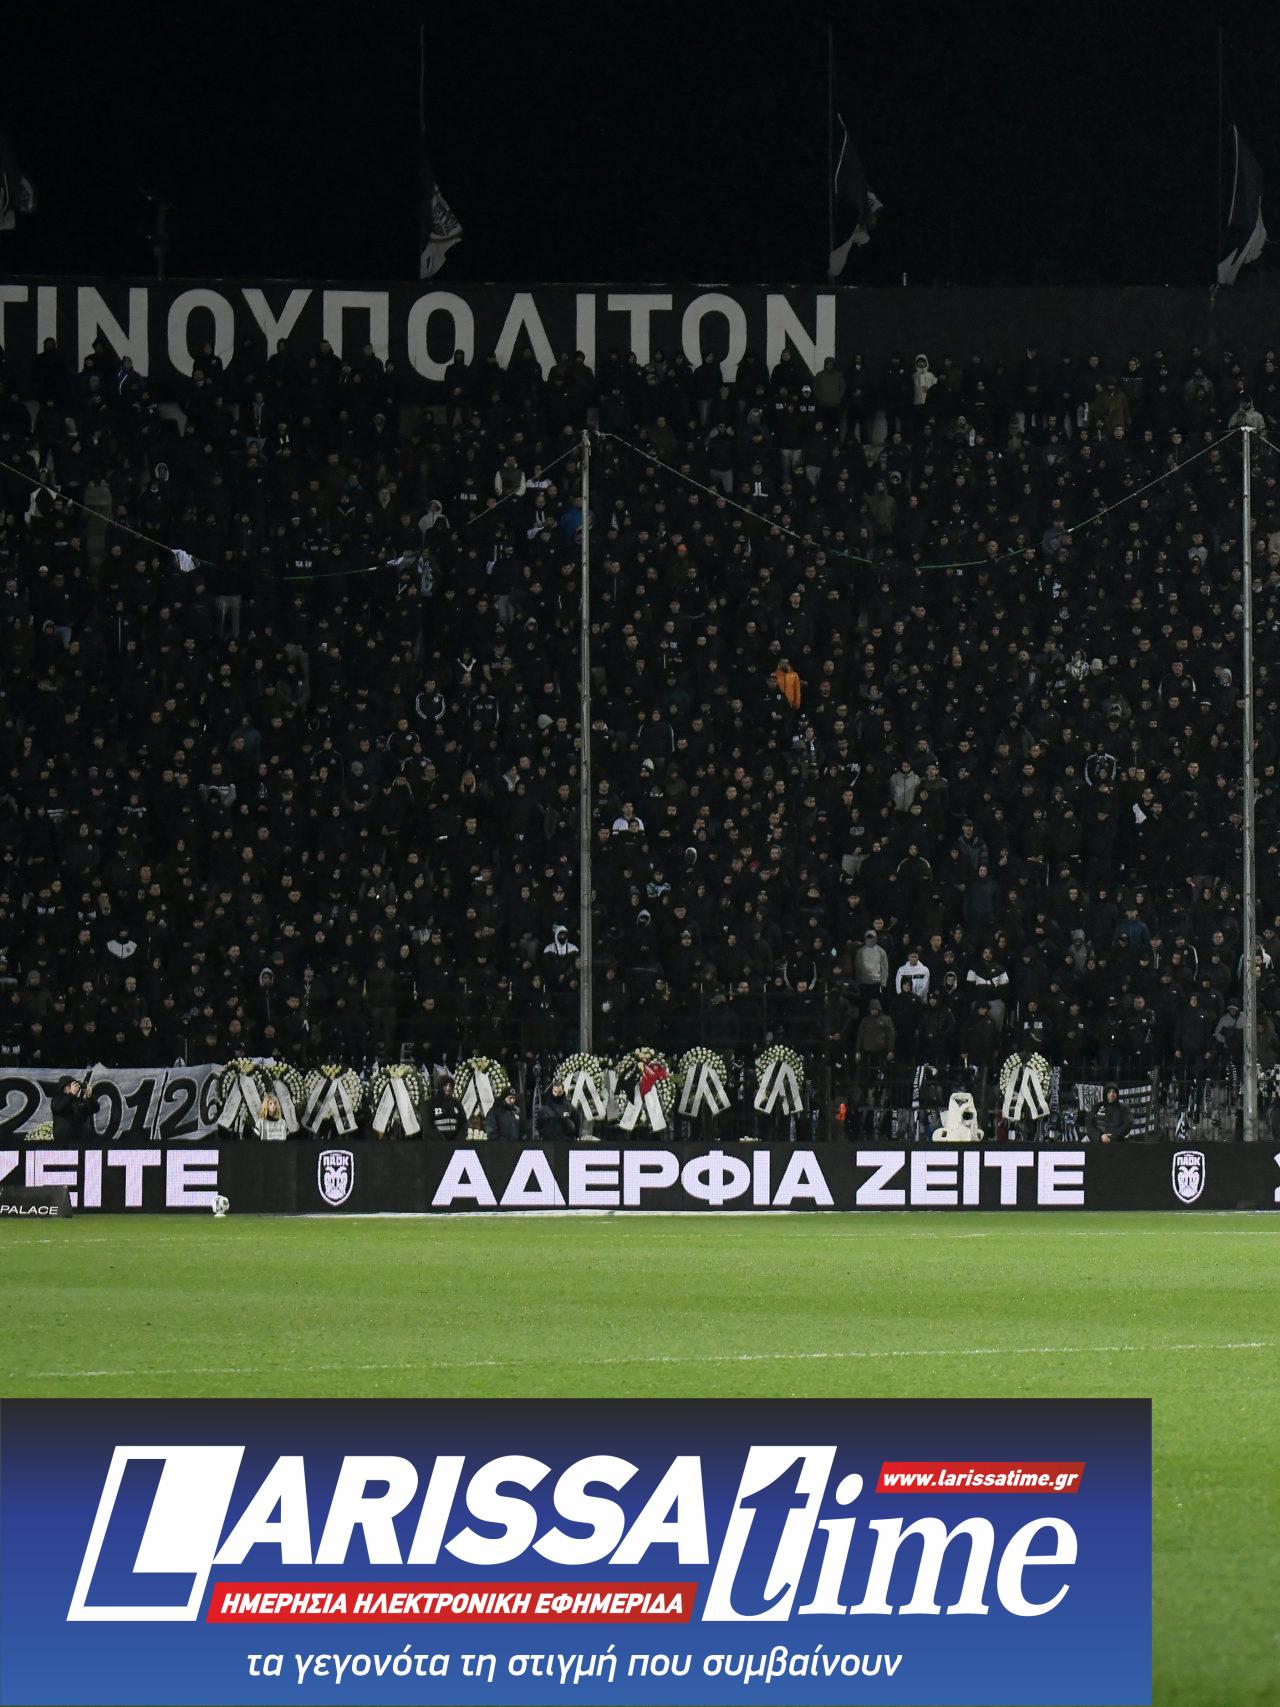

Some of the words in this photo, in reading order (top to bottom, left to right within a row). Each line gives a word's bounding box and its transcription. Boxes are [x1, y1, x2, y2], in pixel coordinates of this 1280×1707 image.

[323, 1155, 349, 1167] ΠΑΟΚ
[1177, 1156, 1201, 1167] ΠΑΟΚ
[431, 1150, 834, 1206] ΑΔΕΡΦΙΑ
[856, 1150, 1085, 1206] ΖΕΙΤΕ
[0, 1204, 59, 1215] PALACE
